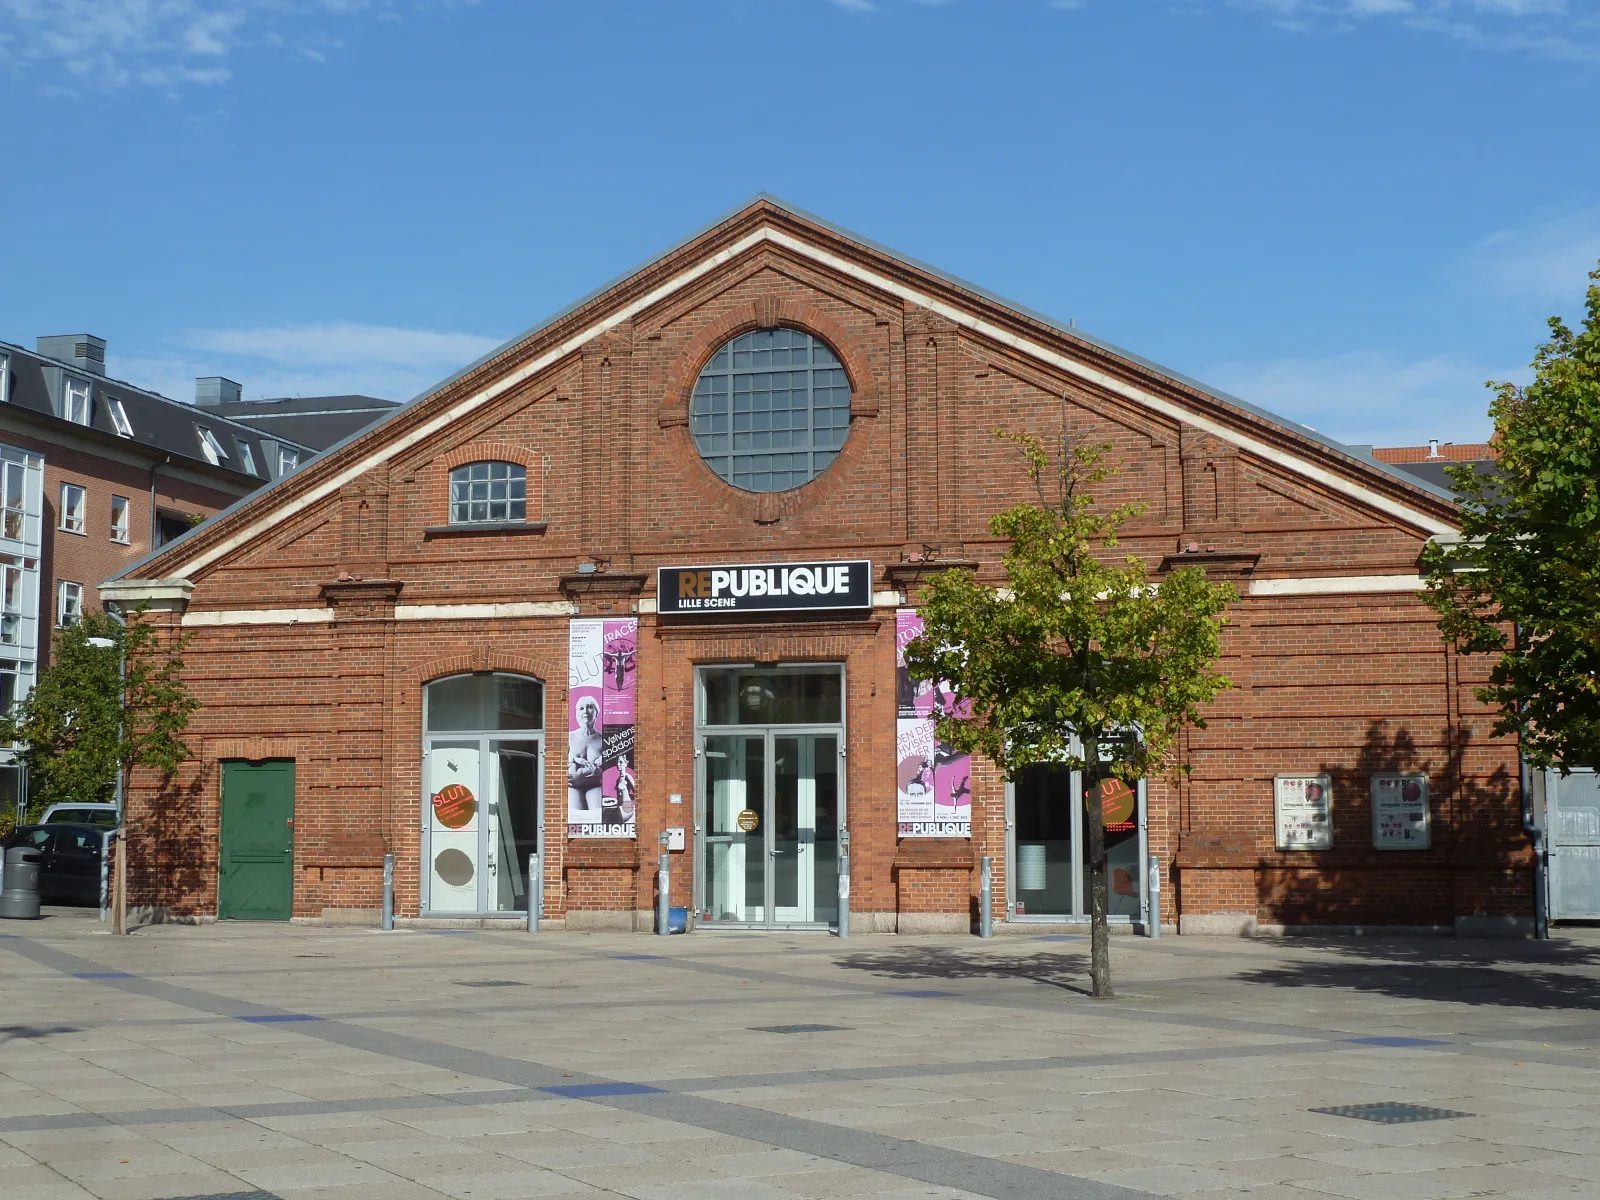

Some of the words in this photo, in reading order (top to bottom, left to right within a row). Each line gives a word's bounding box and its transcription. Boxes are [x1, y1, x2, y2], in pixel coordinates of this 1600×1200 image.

[679, 566, 849, 598] REPUBLIQUE
[679, 598, 702, 608] LILLE
[704, 597, 736, 608] SCENE
[604, 620, 638, 644] TRACES
[603, 726, 635, 746] Vølvens
[602, 736, 635, 758] spådom
[433, 784, 465, 807] SLUT
[568, 824, 635, 836] REPUBLIQUE
[898, 822, 971, 835] REPUBLIQUE
